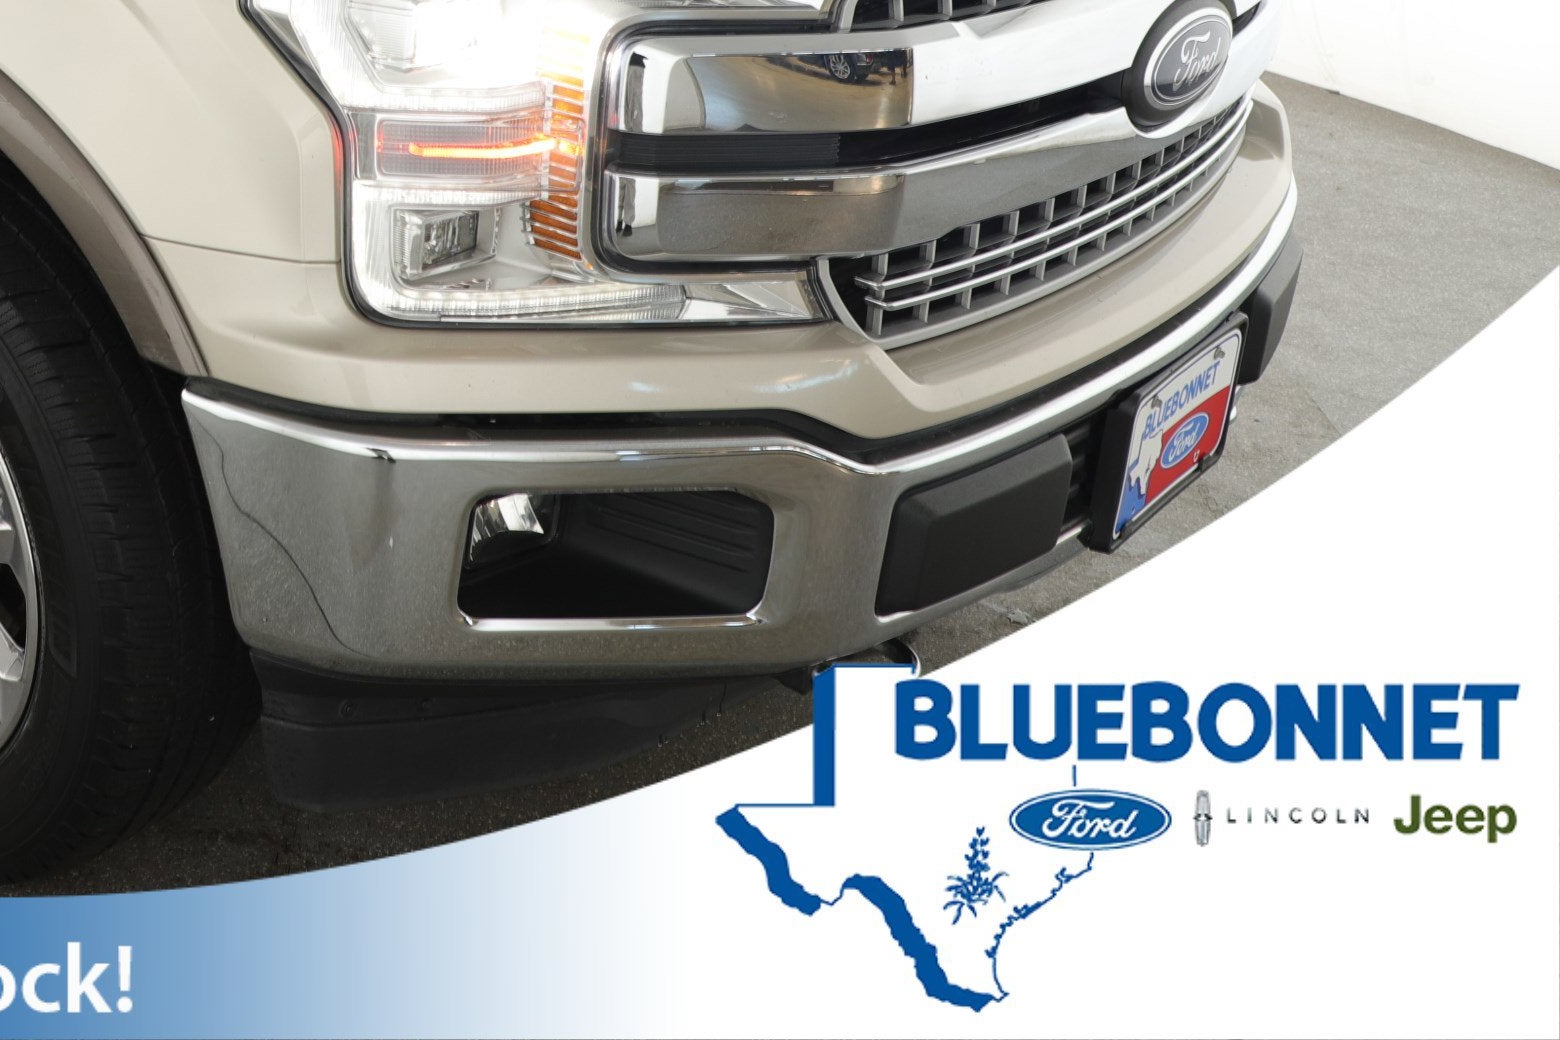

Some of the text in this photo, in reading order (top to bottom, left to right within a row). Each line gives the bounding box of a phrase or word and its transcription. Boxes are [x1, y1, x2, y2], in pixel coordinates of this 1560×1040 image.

[1173, 31, 1221, 90] Ford
[1144, 361, 1220, 436] BLUEBONNET
[1169, 421, 1199, 461] Ford
